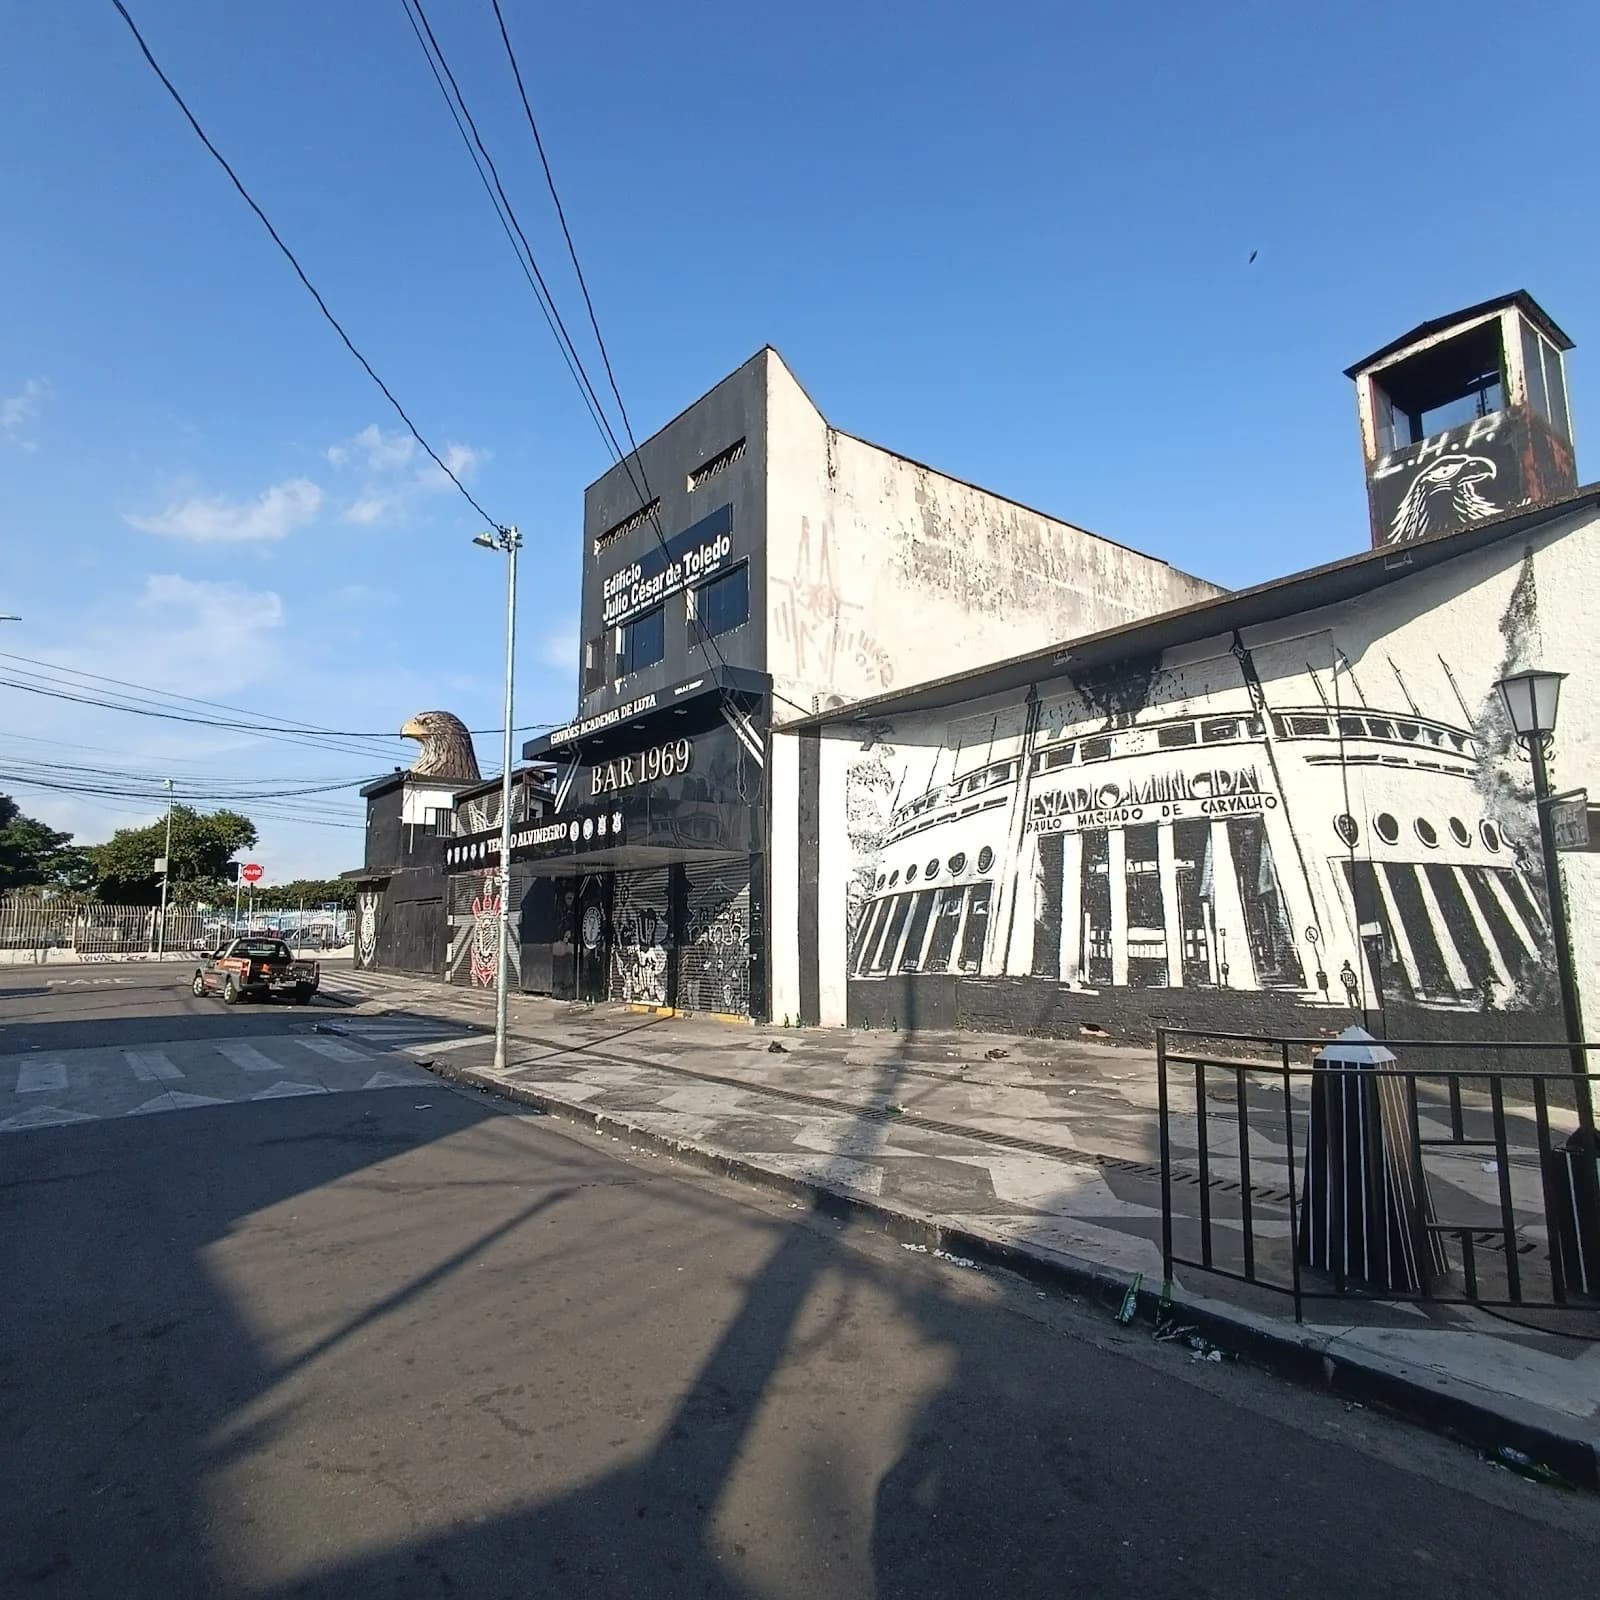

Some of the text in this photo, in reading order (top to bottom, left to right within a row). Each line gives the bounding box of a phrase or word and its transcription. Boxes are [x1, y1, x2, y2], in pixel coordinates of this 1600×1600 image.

[602, 592, 628, 621] Julio
[630, 571, 666, 606] César
[665, 562, 682, 587] de
[683, 535, 730, 576] Toledo
[580, 709, 620, 735] ACADEMIA
[620, 701, 633, 719] DE
[633, 693, 657, 714] LUTA
[590, 738, 690, 796] BAR 1969
[1026, 796, 1278, 834] PAULO MACHADO DE CARVALHO
[487, 822, 567, 853] TEMO ALVINEGRO
[243, 868, 263, 876] PARE
[47, 976, 136, 987] PARE
